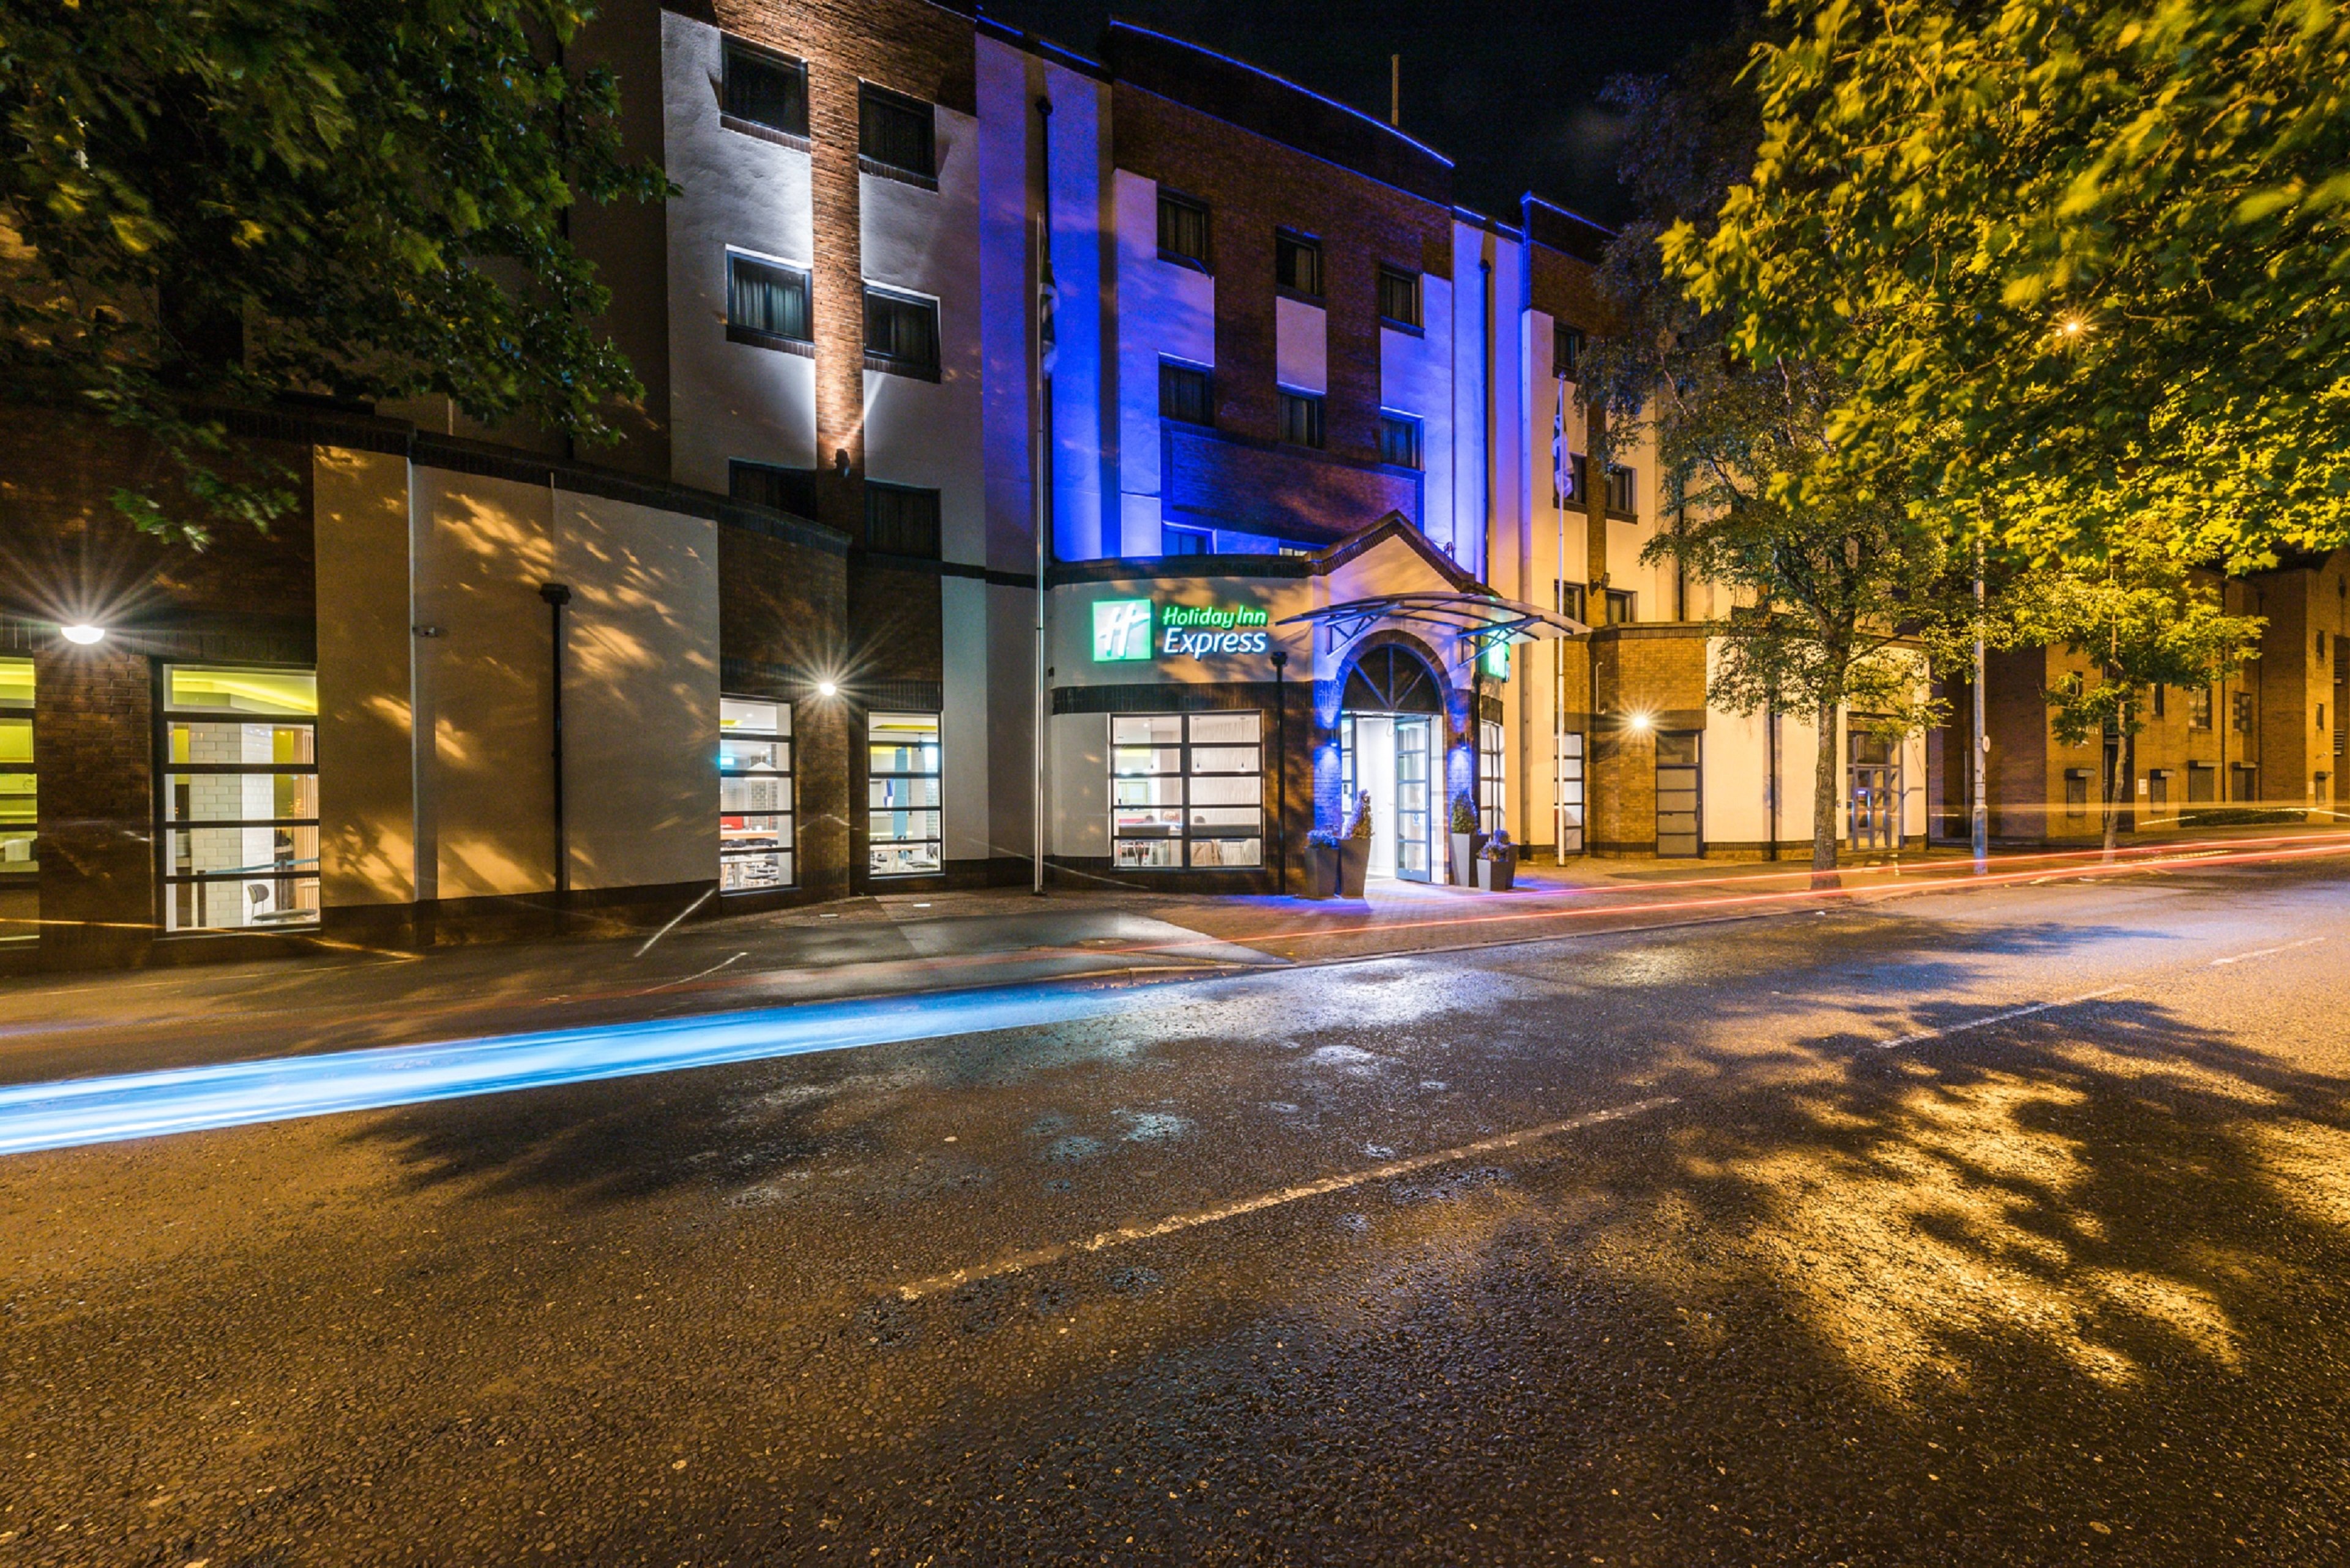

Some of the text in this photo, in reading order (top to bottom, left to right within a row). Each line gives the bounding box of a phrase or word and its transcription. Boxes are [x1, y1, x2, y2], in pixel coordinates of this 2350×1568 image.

[1163, 605, 1267, 628] Holiday Inn
[1163, 627, 1267, 659] Express
